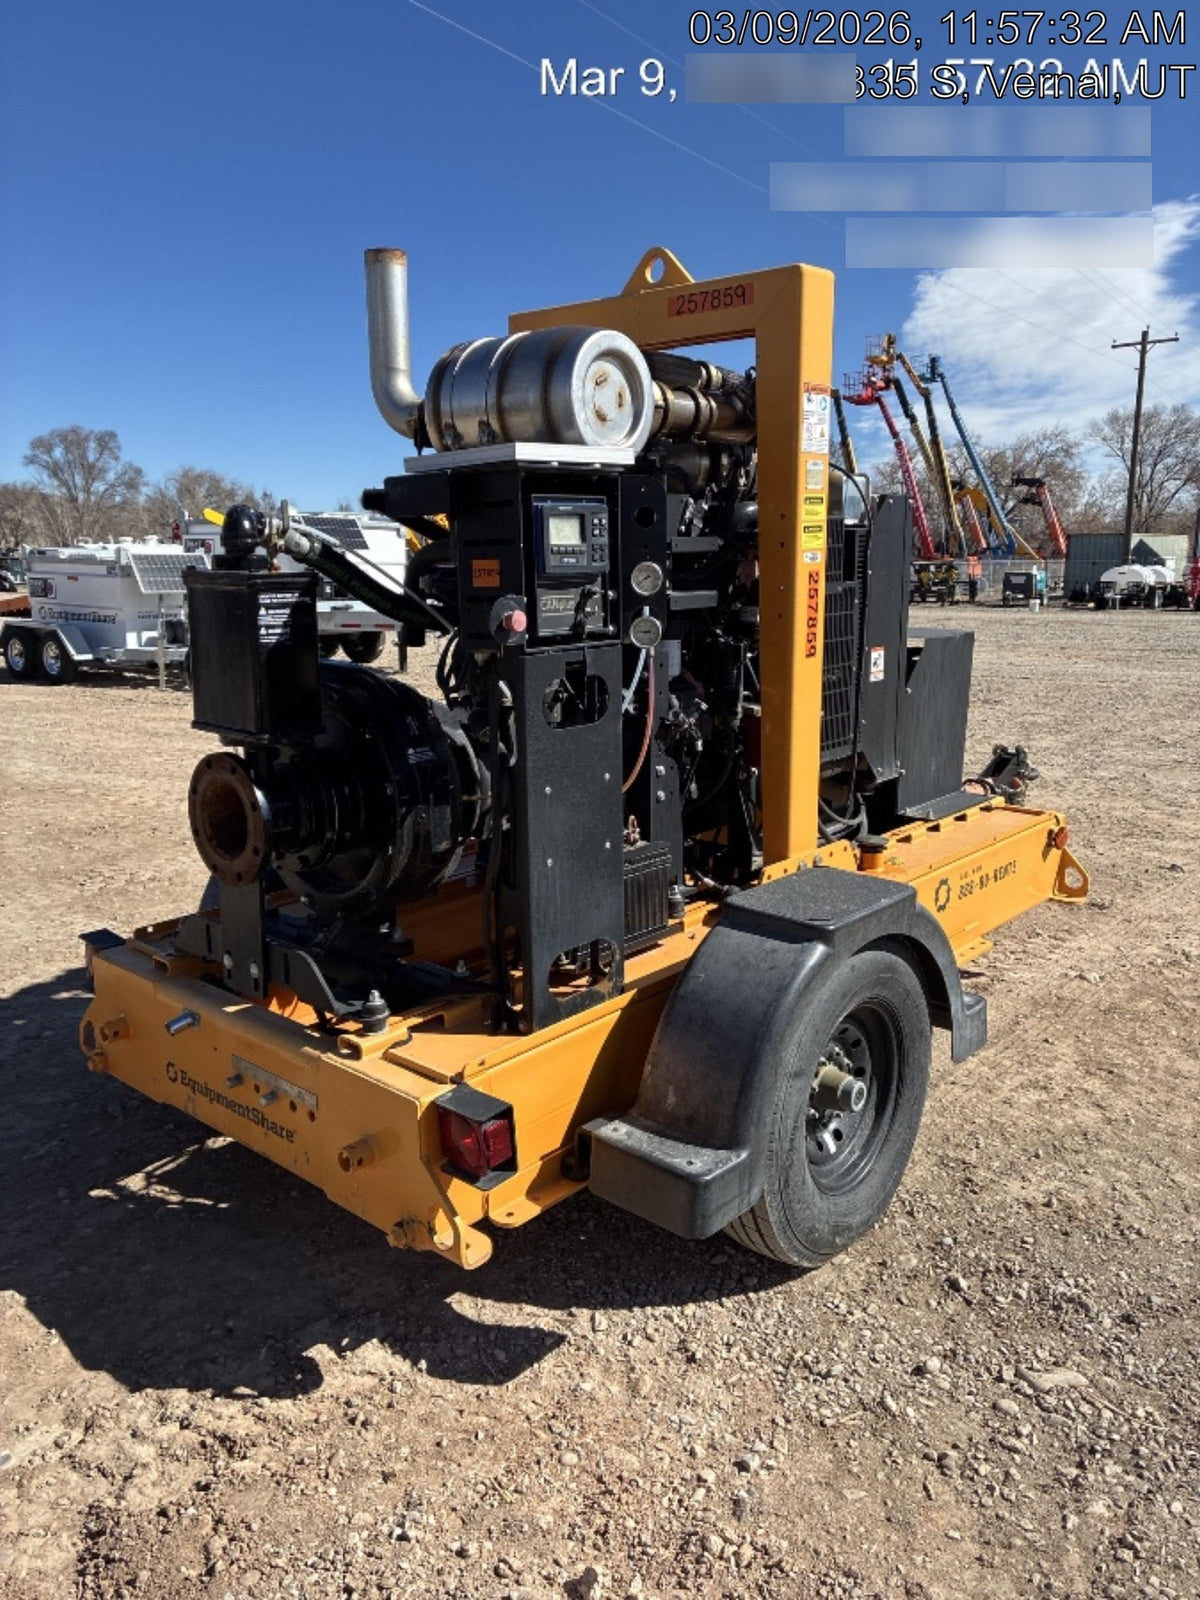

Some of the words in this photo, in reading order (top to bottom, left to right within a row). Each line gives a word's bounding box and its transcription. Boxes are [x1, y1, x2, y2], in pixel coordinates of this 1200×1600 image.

[676, 284, 746, 316] 257859
[806, 571, 819, 658] 257859
[180, 1069, 295, 1143] EquipmentShare
